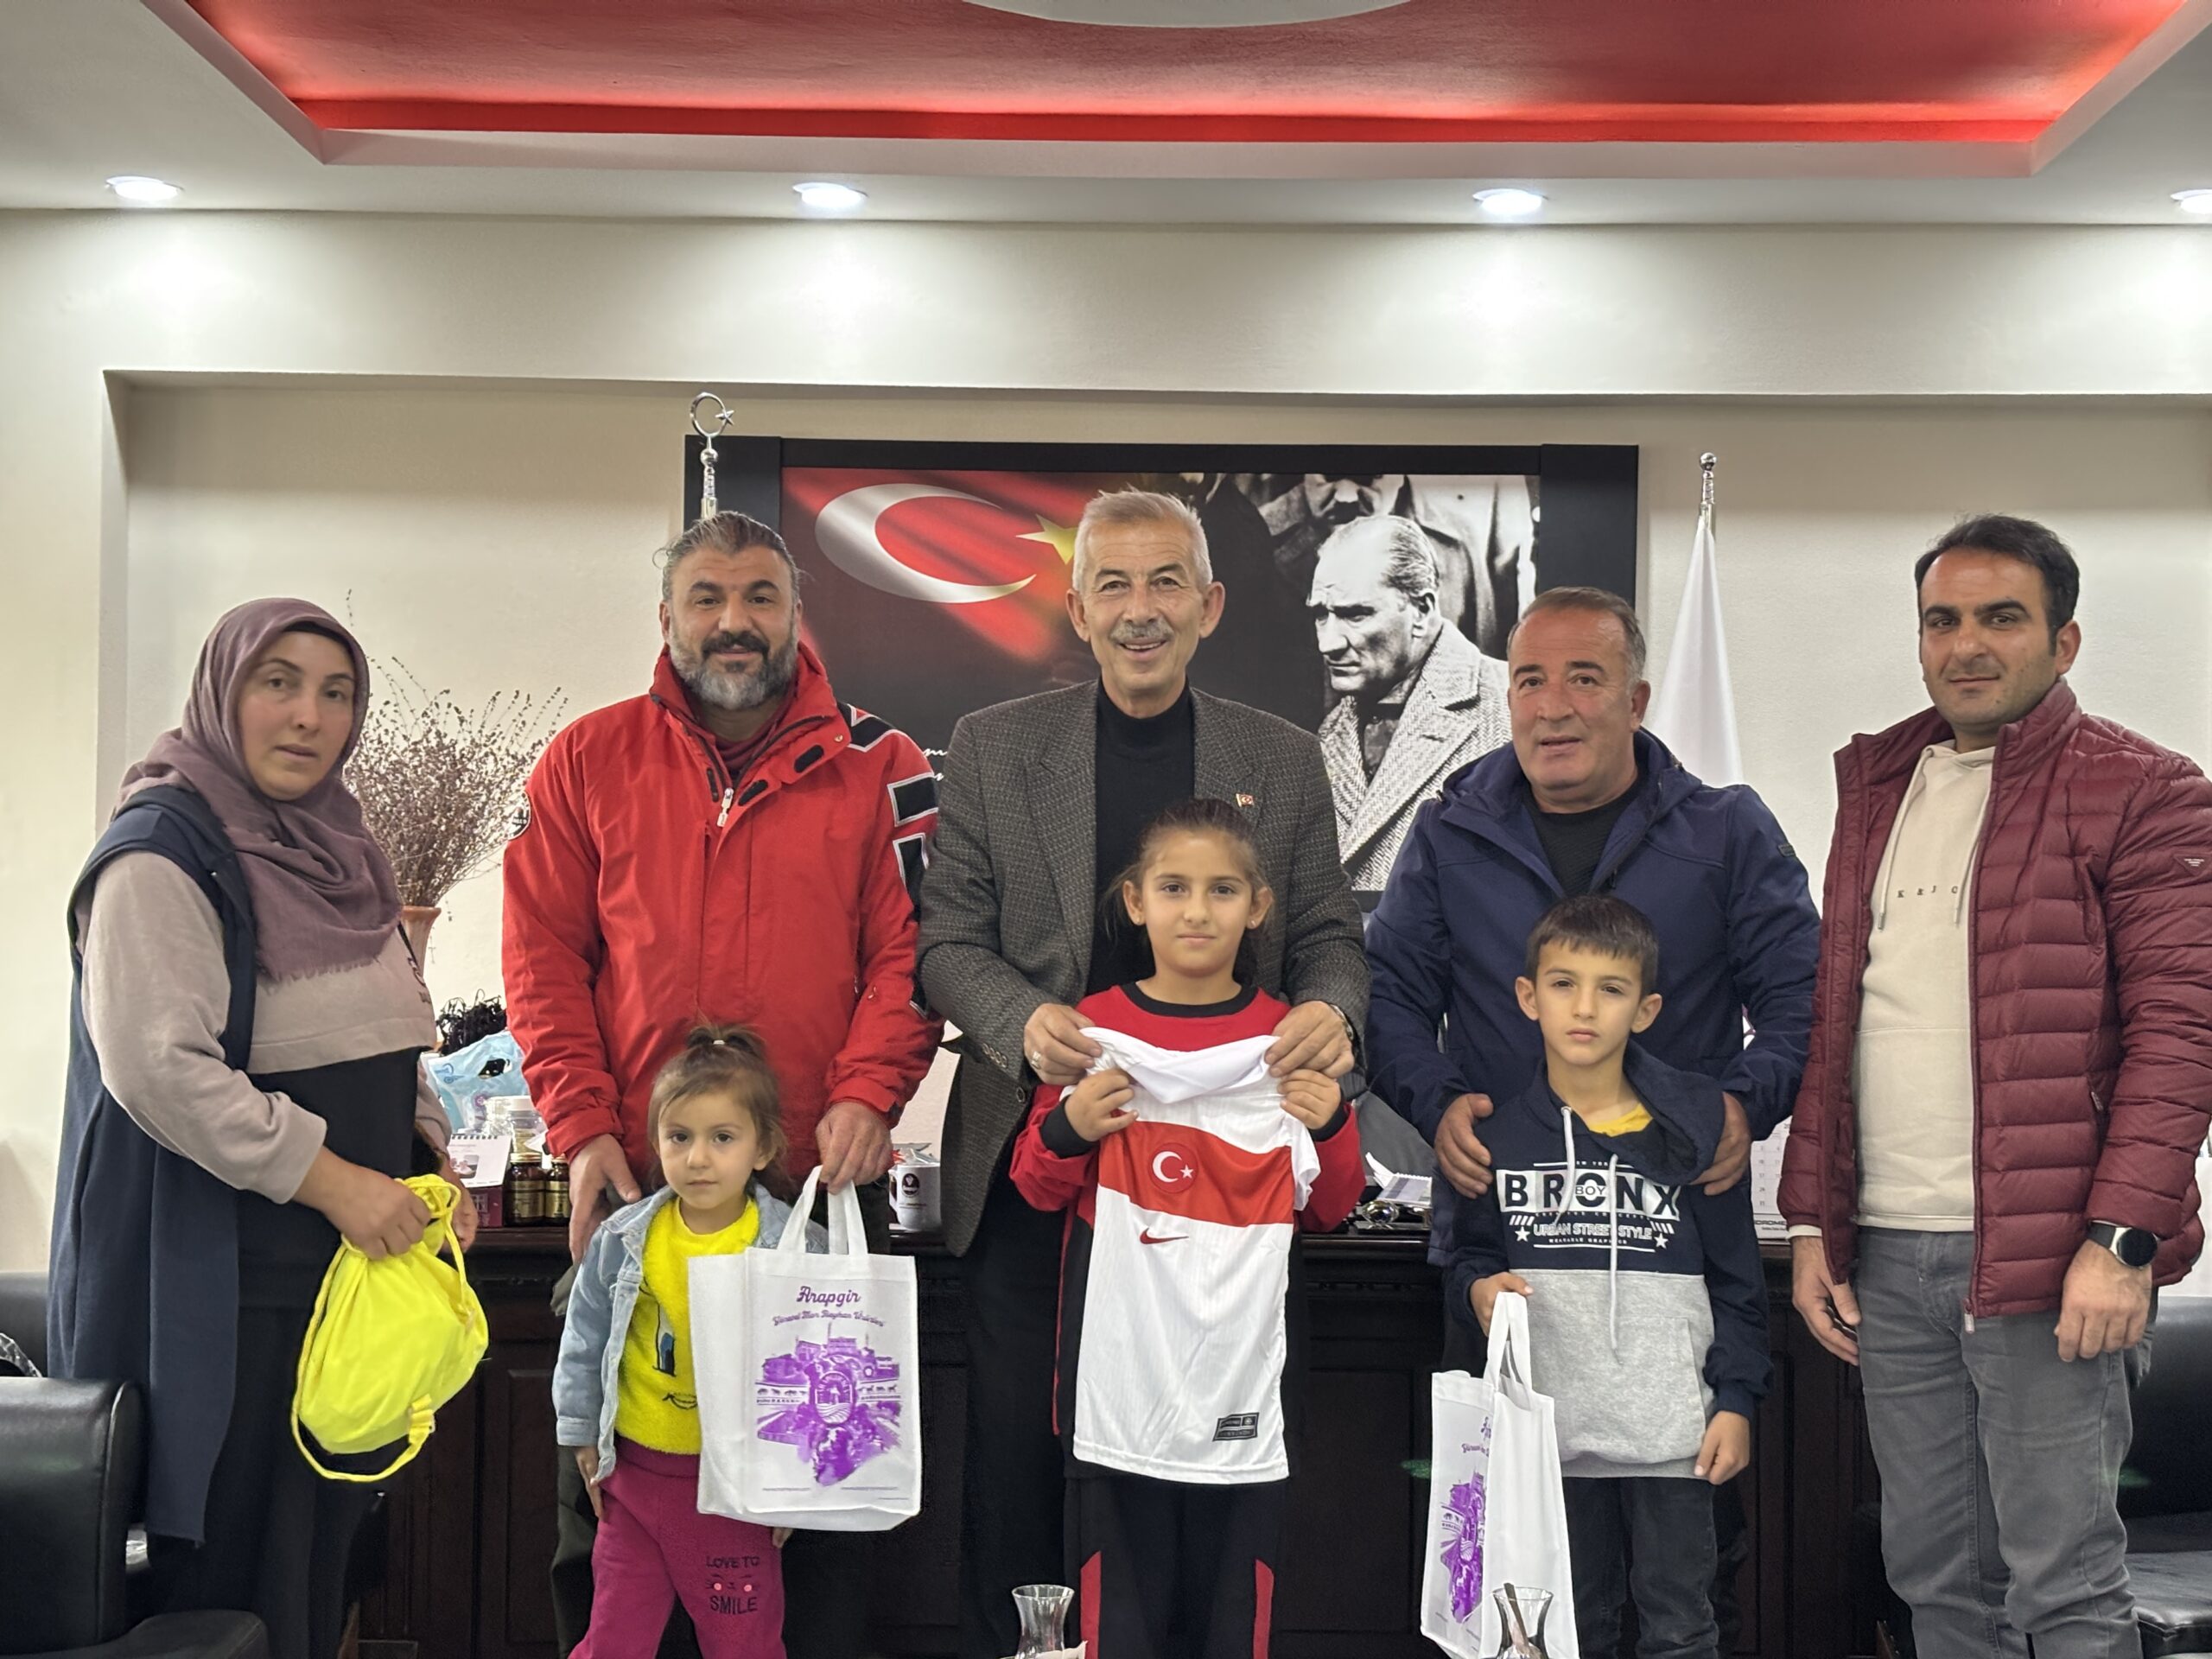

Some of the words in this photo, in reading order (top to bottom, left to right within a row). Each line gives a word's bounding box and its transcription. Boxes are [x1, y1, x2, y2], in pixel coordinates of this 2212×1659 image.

[1504, 1172, 1678, 1217] BRONX
[1575, 1185, 1606, 1196] BOY
[1573, 1223, 1612, 1236] STREE
[1618, 1224, 1653, 1240] STYLE
[796, 1286, 861, 1307] Arapgir
[706, 1555, 739, 1569] LOVE
[741, 1555, 760, 1568] TO
[709, 1595, 759, 1616] SMILE
